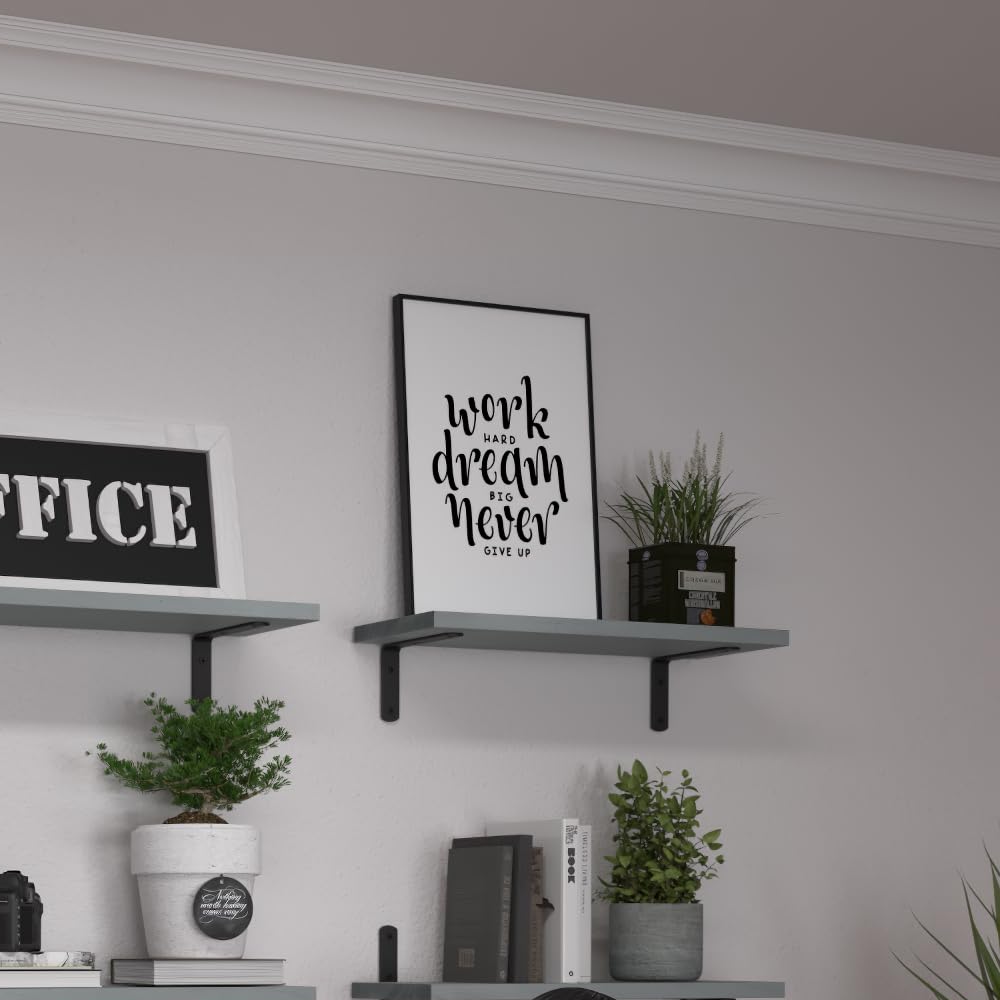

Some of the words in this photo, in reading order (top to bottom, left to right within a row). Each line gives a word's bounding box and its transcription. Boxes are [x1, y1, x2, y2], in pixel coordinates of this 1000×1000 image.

[444, 375, 550, 440] work
[483, 433, 516, 445] HARD
[432, 429, 568, 503] dream
[489, 491, 514, 502] BIG
[484, 546, 512, 557] GIVE
[517, 548, 531, 558] UP
